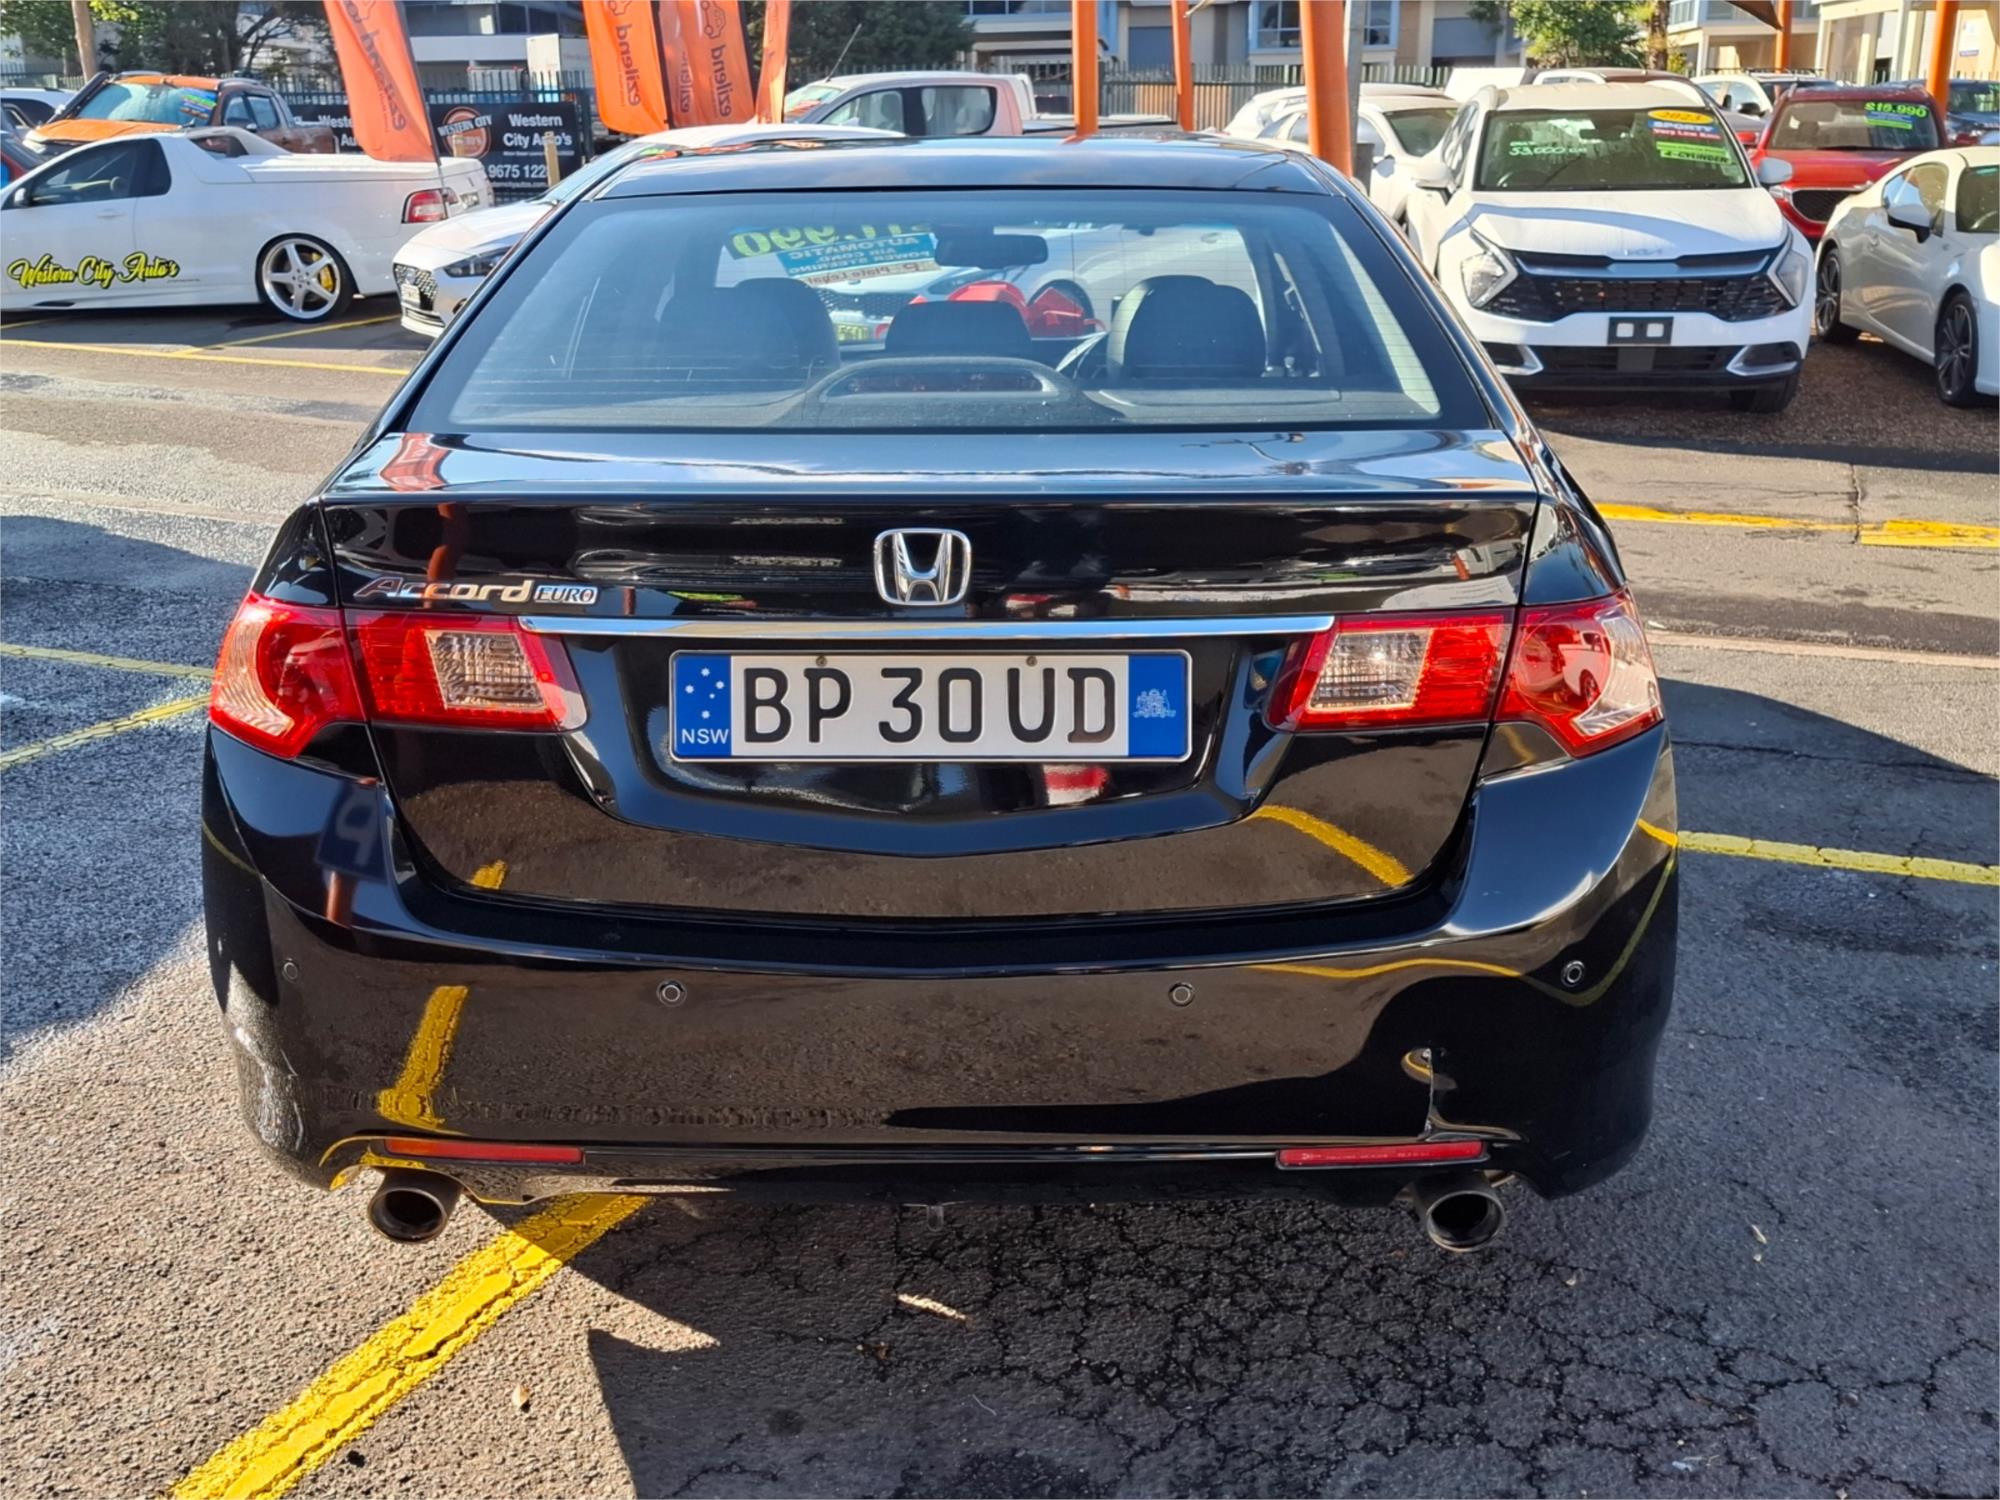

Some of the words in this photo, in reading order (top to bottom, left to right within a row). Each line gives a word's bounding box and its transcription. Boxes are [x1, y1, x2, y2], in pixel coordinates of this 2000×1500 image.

[508, 113, 563, 127] Western
[503, 132, 530, 149] City
[532, 132, 573, 146] Ao's
[488, 164, 520, 178] 9675
[523, 164, 549, 178] 122
[7, 253, 76, 289] Western
[77, 255, 116, 289] City
[117, 251, 181, 283] Auto's
[354, 576, 535, 603] Accord
[535, 584, 598, 605] EURO
[743, 667, 854, 744] BP
[877, 667, 983, 744] 30
[1006, 667, 1116, 744] UD
[680, 728, 730, 746] NSW
